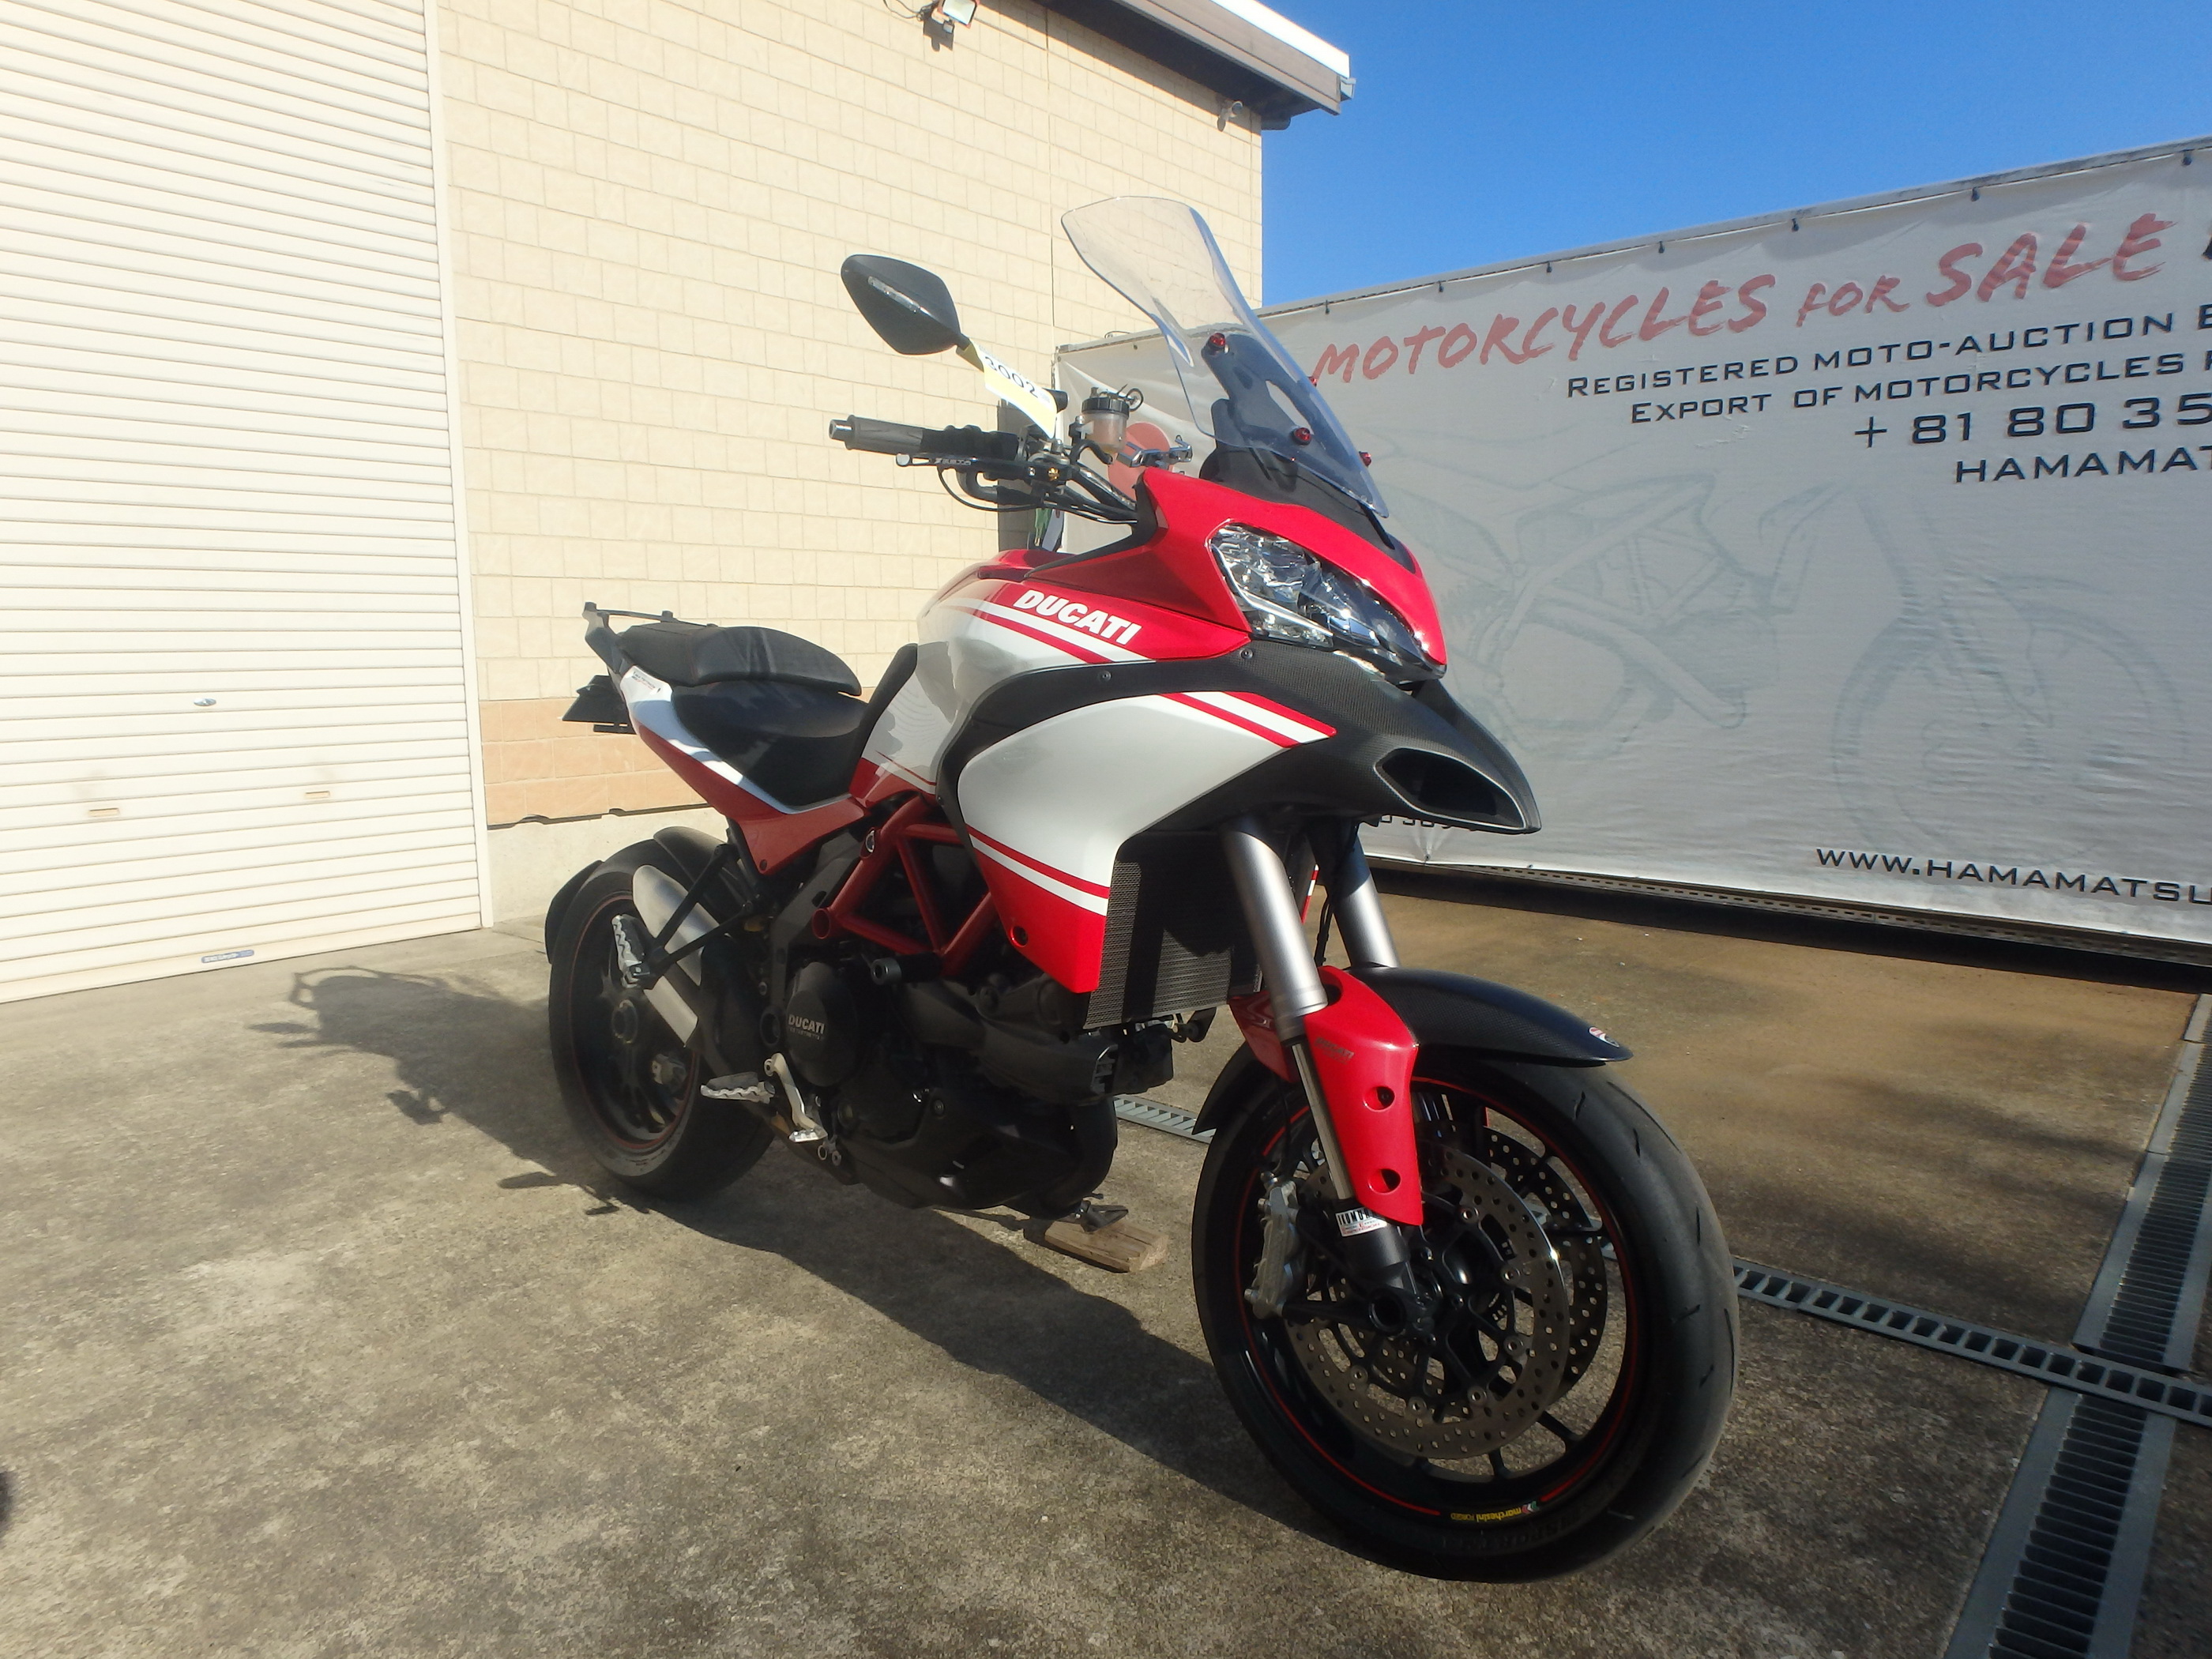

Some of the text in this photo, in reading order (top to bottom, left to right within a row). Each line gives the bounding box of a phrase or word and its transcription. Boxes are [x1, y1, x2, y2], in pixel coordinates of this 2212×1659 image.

[1313, 274, 1775, 383] MOTORCYCLES
[1925, 213, 2180, 306] SALE
[1568, 356, 1798, 398] REGISTERED
[1815, 312, 2173, 371] MOTO-AUCTION
[1632, 393, 1772, 423] EXPORT
[1793, 386, 1842, 408] OF
[1854, 352, 2184, 401] MOTORCYCLES
[1911, 412, 1973, 444] 81
[2007, 402, 2095, 438] 80
[1012, 589, 1143, 646] DUCATI
[1816, 848, 2212, 906] WWW.HAMAMATSU
[788, 1014, 825, 1034] DUCATI
[1476, 1507, 1522, 1522] marchesini
